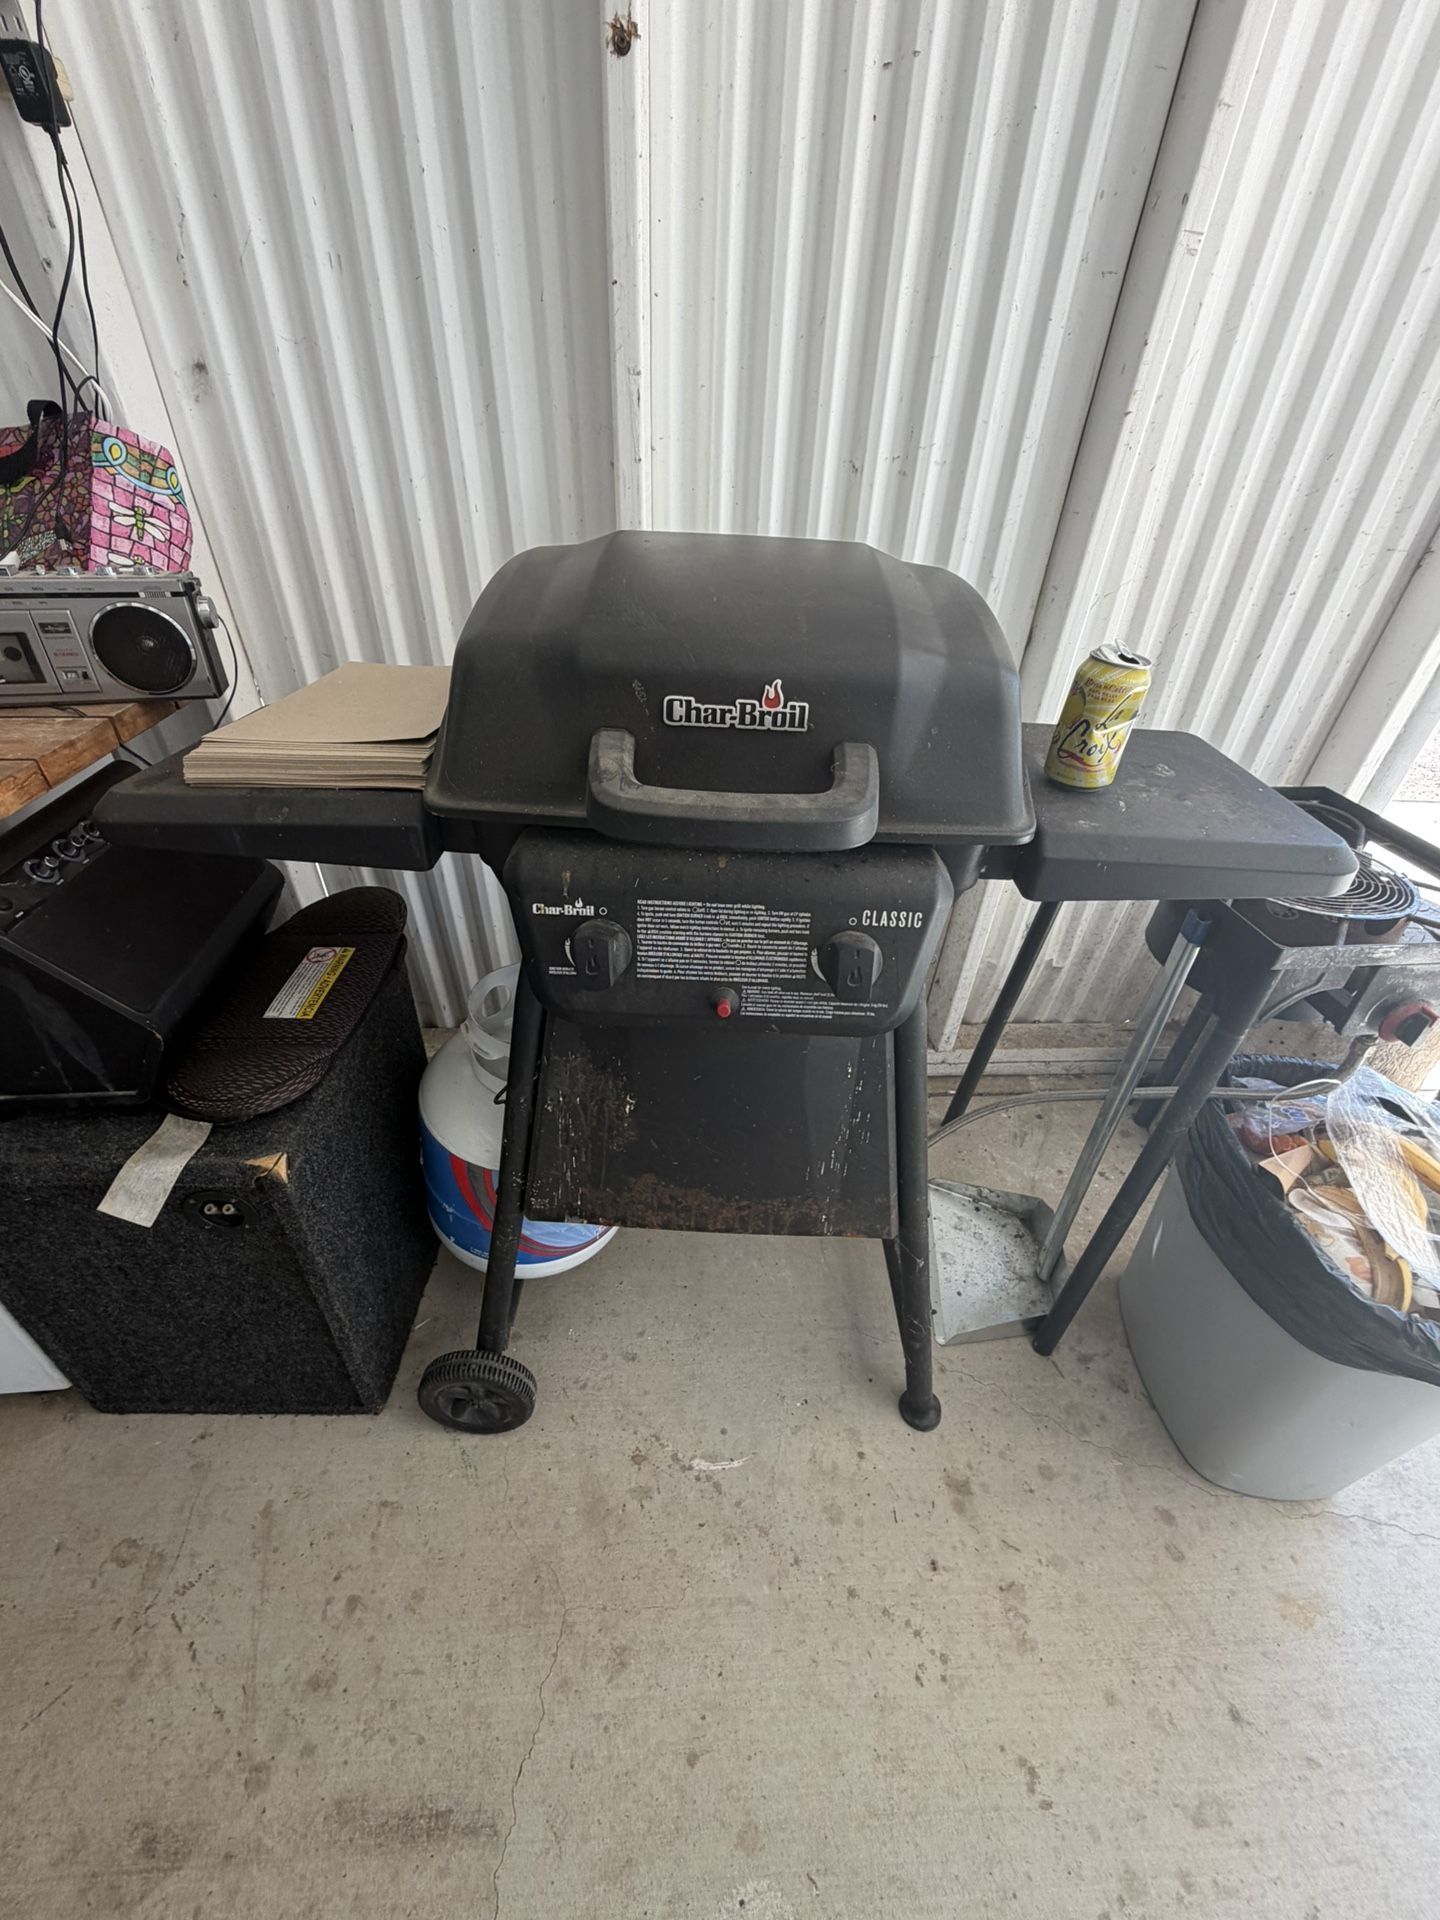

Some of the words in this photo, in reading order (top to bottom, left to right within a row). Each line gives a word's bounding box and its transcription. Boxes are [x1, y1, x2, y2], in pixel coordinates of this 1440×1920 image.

[664, 695, 809, 732] Char-Broil
[1057, 719, 1118, 767] Croix
[532, 903, 595, 917] Char-Broil
[862, 909, 923, 929] CLASSIC
